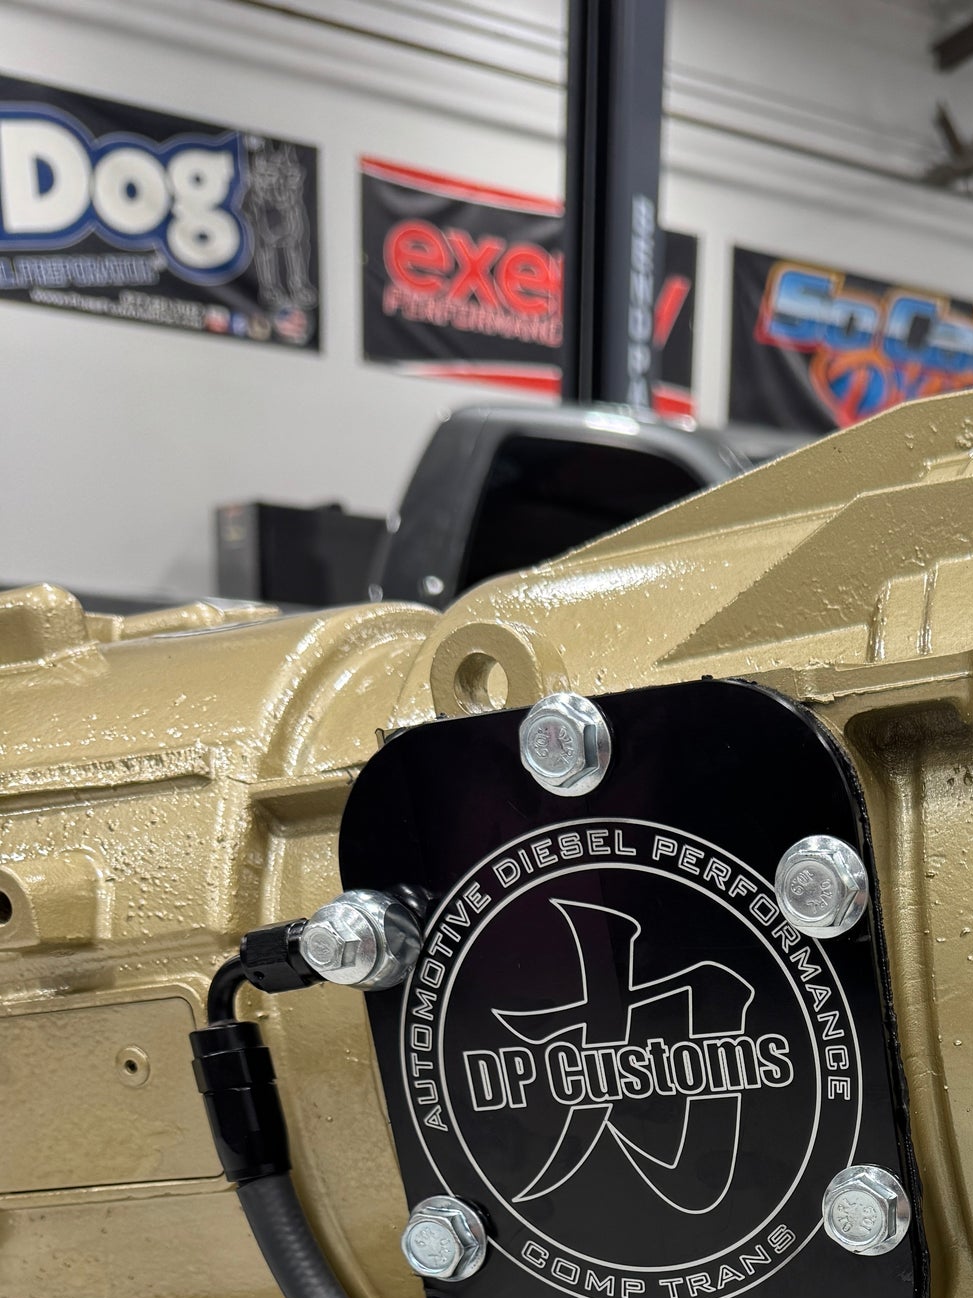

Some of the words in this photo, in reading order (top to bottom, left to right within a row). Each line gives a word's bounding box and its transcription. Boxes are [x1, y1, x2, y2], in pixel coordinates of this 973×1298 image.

[0, 119, 241, 270] Dog
[411, 883, 491, 1132] AUTOMOTIVE
[492, 829, 636, 888] DIESEL
[652, 835, 850, 1101] PERFORMANCE
[463, 1047, 536, 1111] DP
[545, 1033, 794, 1105] Customs
[521, 1240, 646, 1298] COMP
